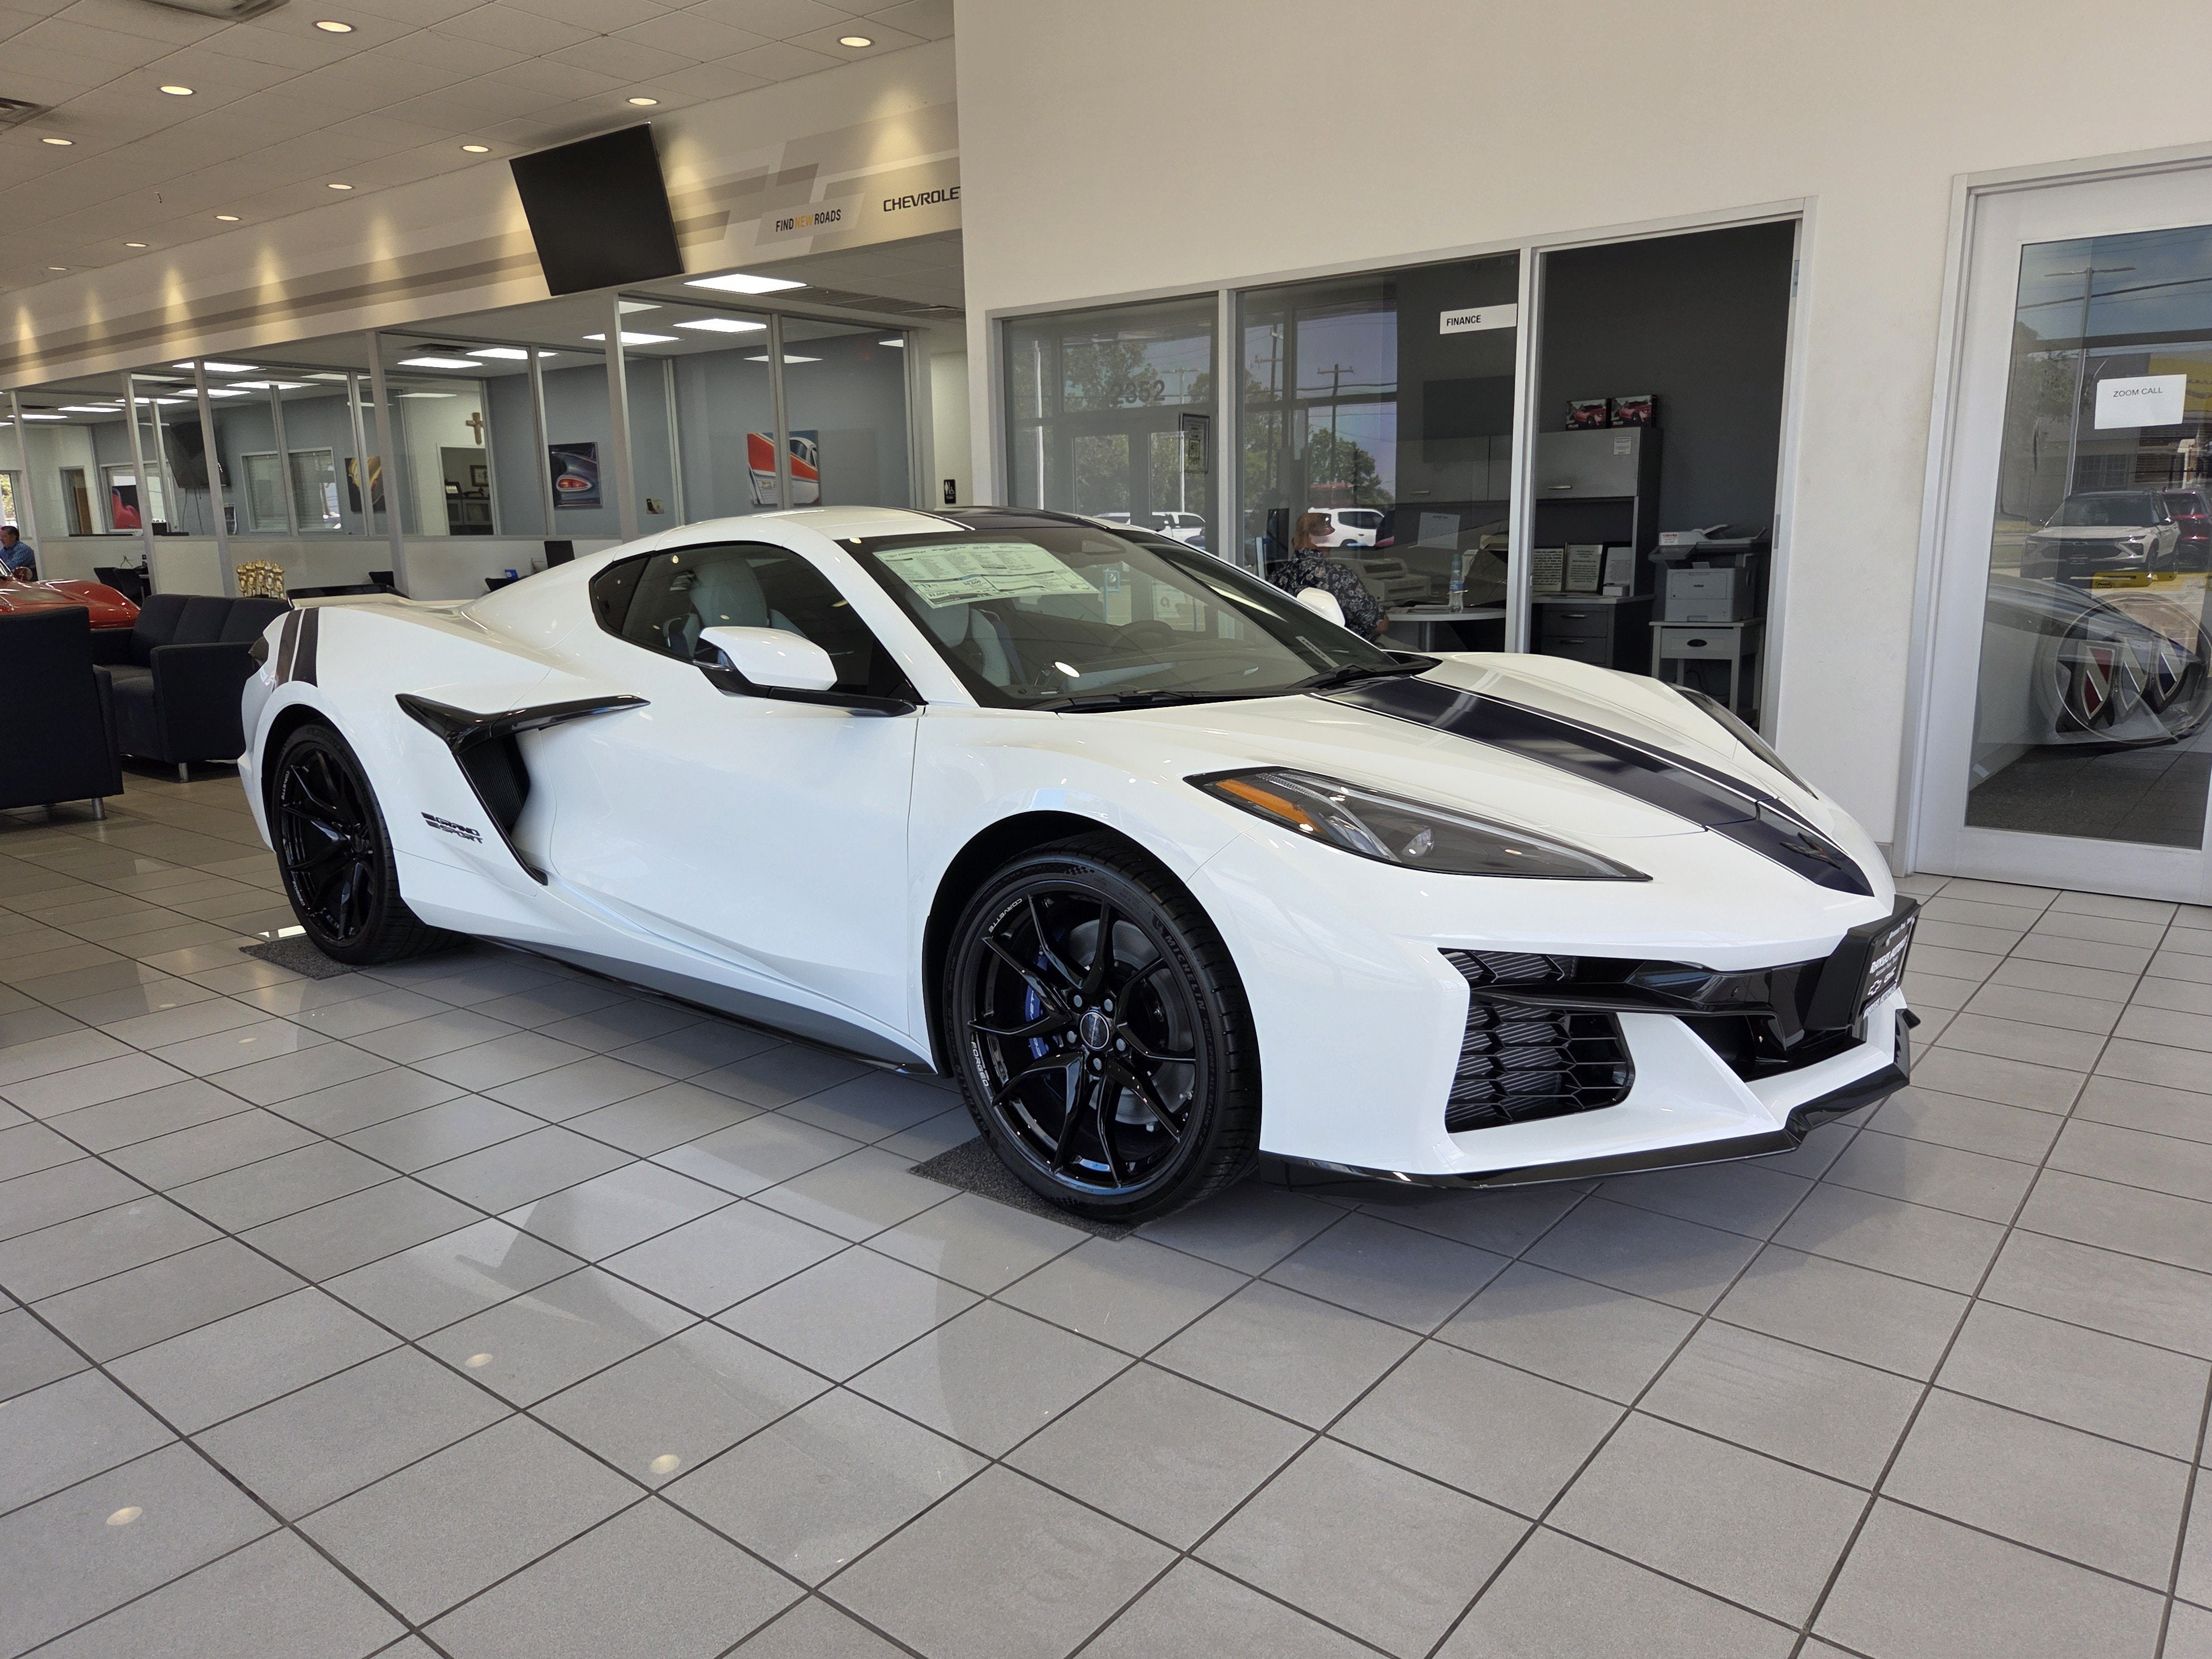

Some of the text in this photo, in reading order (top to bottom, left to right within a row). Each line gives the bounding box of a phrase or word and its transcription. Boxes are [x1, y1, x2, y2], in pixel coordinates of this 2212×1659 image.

[775, 209, 842, 232] FIND NEW ROADS
[1446, 315, 1481, 326] FINANCE
[2113, 389, 2139, 398] ZOOM
[435, 817, 480, 836] GRAND
[440, 825, 483, 844] SPORT
[988, 898, 1022, 933] CORVETTE
[1165, 935, 1207, 1010] MICHELIN
[971, 1041, 989, 1087] FORGED
